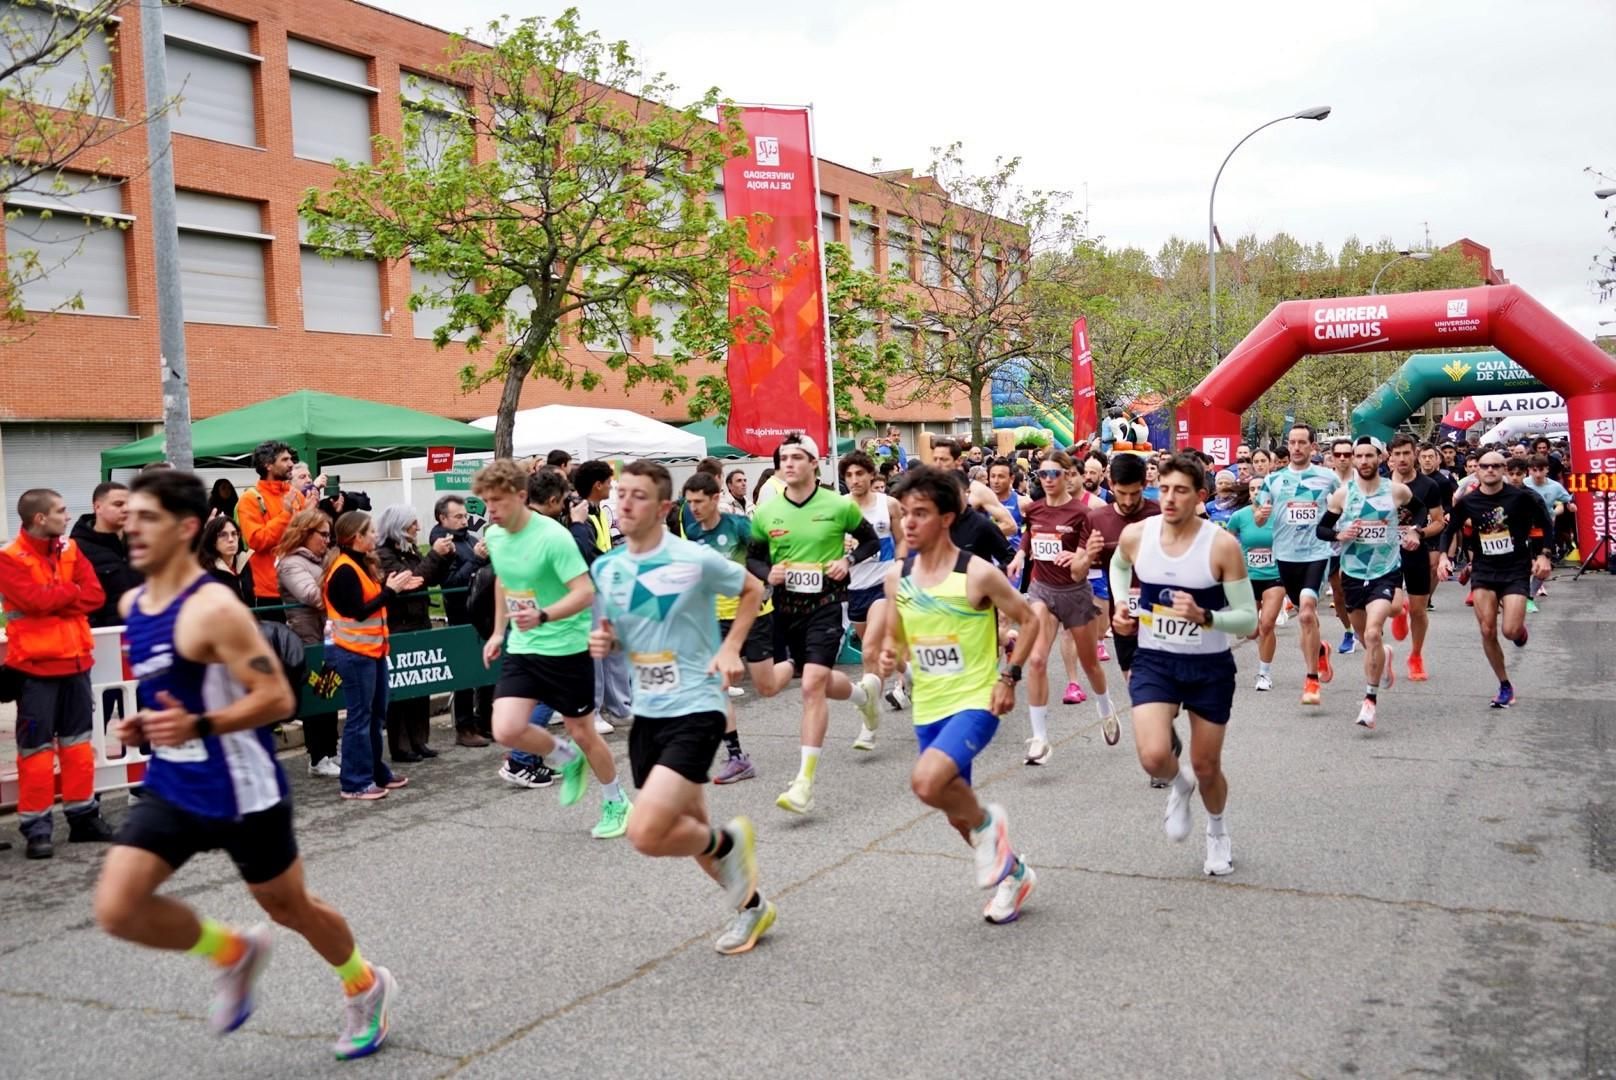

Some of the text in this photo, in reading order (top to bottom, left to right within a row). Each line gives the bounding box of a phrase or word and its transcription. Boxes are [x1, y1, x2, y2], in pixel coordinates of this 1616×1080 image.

[1314, 305, 1388, 323] CARRERA
[1434, 319, 1480, 327] UNIVERSIDAD
[1314, 322, 1381, 340] CAMPUS
[1476, 361, 1507, 371] CAJA
[1476, 370, 1535, 381] DE NAVA
[1487, 400, 1512, 412] LA
[1453, 410, 1475, 422] LR
[1289, 509, 1316, 520] 1653
[1357, 527, 1385, 539] 2252
[1034, 542, 1060, 554] 1503
[1484, 538, 1509, 550] 1107
[1249, 553, 1272, 563] 2251
[787, 571, 820, 586] 2030
[1156, 618, 1200, 636] 1072
[396, 648, 447, 669] RURAL
[916, 647, 959, 666] 1094
